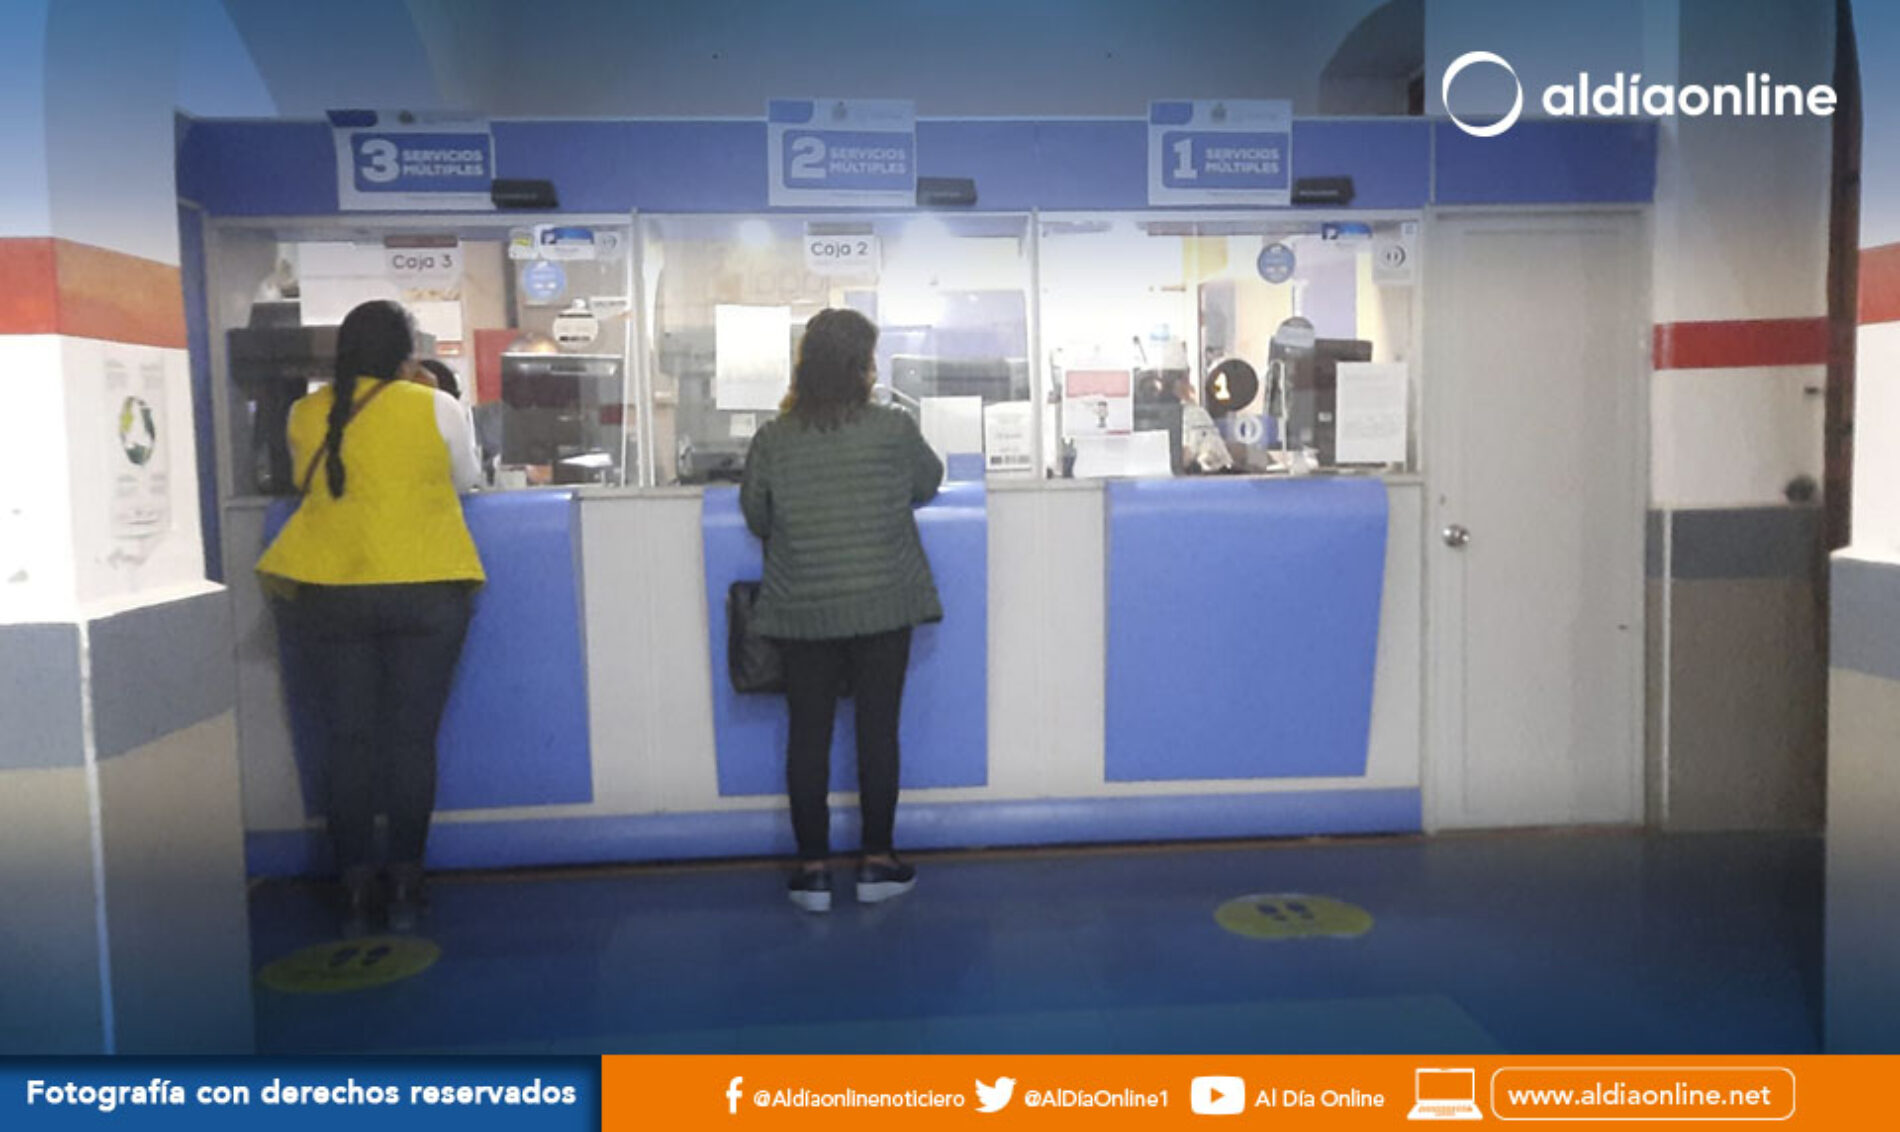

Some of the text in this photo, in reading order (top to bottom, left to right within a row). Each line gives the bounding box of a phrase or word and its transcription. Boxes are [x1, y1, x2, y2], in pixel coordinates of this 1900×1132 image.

[360, 138, 400, 183] 3
[402, 150, 484, 162] SERVICIOS
[791, 136, 827, 179] 2
[829, 148, 906, 160] SERVICIOS
[1173, 138, 1197, 179] 1
[1205, 148, 1280, 160] SERVICIOS
[810, 240, 869, 258] Caja 2
[392, 253, 454, 273] Caja 3
